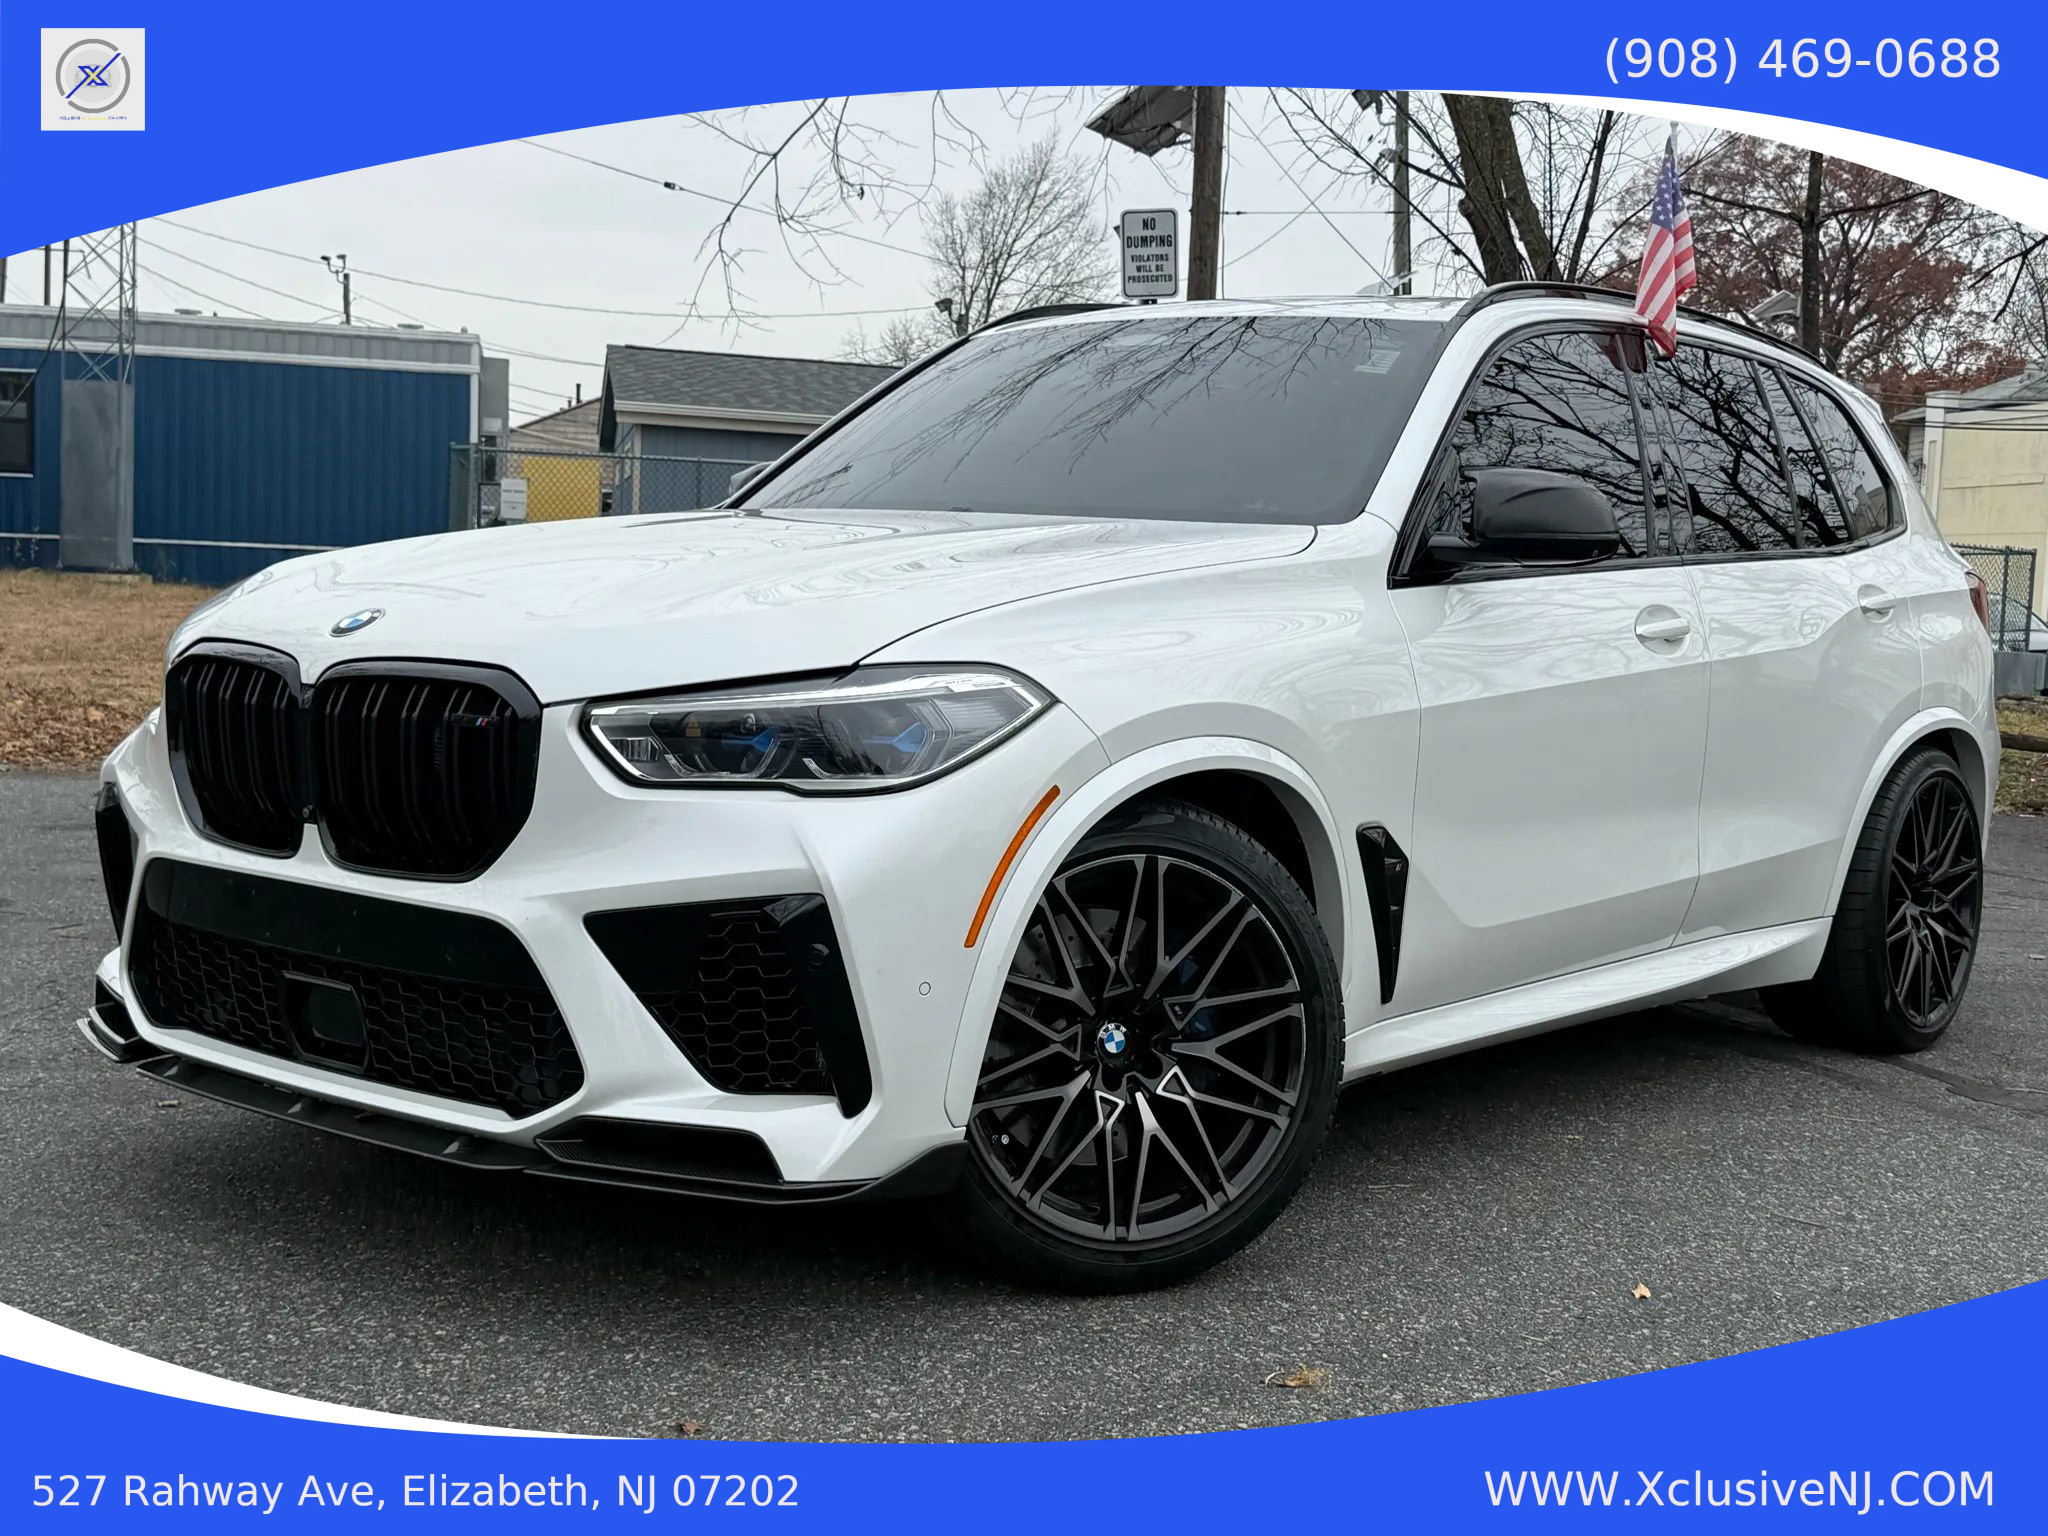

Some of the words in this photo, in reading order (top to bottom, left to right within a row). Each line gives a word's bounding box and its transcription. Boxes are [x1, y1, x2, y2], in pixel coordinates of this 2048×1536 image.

[1142, 217, 1156, 231] NO
[1126, 234, 1173, 249] DUMPING
[1130, 253, 1169, 263] VIOLATORS
[1136, 264, 1152, 273] WILL
[1155, 264, 1164, 272] BE
[1127, 274, 1173, 284] PROSECUTED
